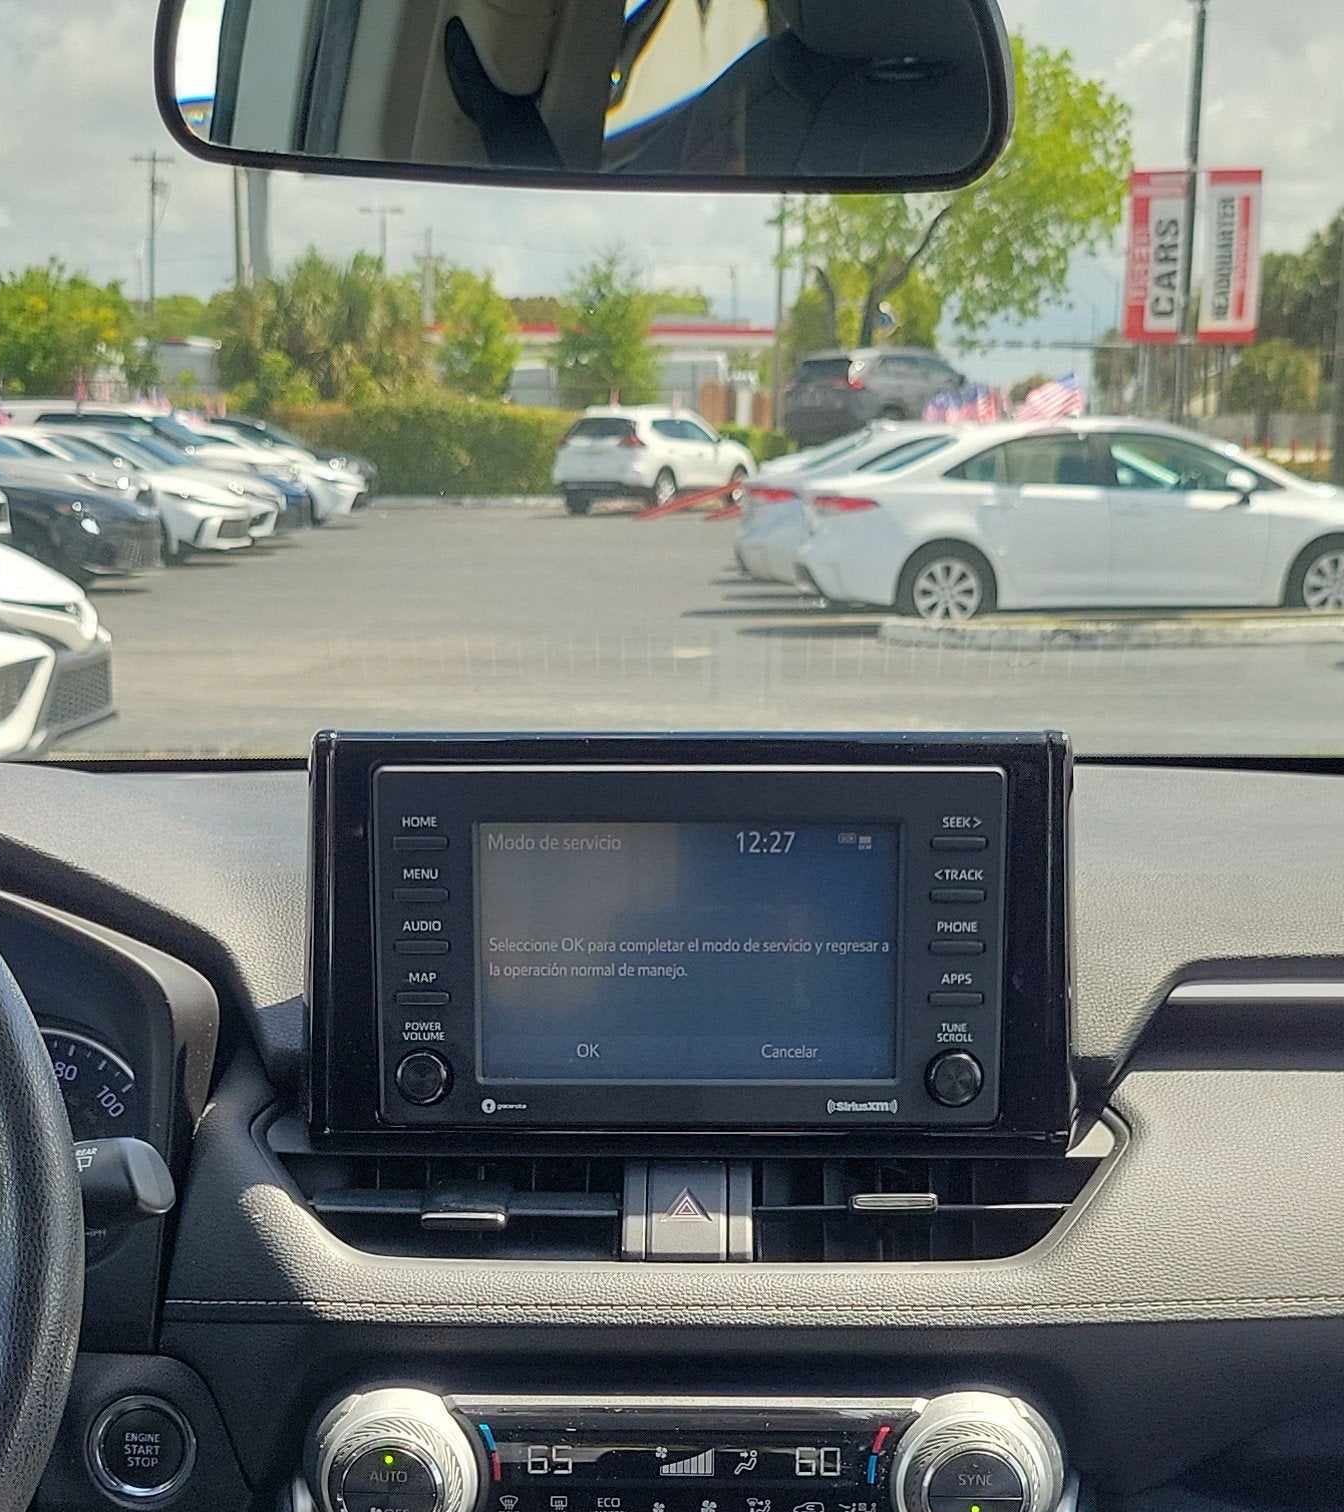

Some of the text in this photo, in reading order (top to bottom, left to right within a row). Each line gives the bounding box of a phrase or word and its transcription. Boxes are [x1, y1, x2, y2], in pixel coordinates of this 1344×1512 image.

[1151, 219, 1179, 317] CARS
[402, 816, 437, 827] HOME
[488, 833, 622, 851] Modo de servicio
[736, 831, 796, 854] 12:27
[403, 869, 438, 880] MENU
[403, 920, 441, 931] AUDIO
[937, 921, 978, 932] PHONE
[488, 937, 889, 958] Seleccione OK para completar el modo de servicio y regresar a
[489, 963, 687, 981] la operación normal de manejo.
[409, 973, 437, 983] MAP
[941, 974, 973, 984] APPS
[405, 1022, 441, 1031] POWER
[941, 1023, 967, 1032] TUNE
[403, 1032, 445, 1041] VOLUME
[937, 1033, 973, 1042] SCROLL
[576, 1044, 600, 1058] OK
[761, 1044, 817, 1059] Cancelar
[55, 1061, 77, 1081] 80
[96, 1085, 125, 1117] 100
[75, 1147, 97, 1156] REAR
[125, 1432, 161, 1443] ENGINE
[124, 1444, 161, 1456] START
[126, 1457, 159, 1467] STOP
[528, 1445, 573, 1474] 65
[795, 1447, 841, 1476] 60
[370, 1470, 407, 1483] AUTO
[958, 1473, 994, 1486] SYNC
[597, 1498, 621, 1508] ECO
